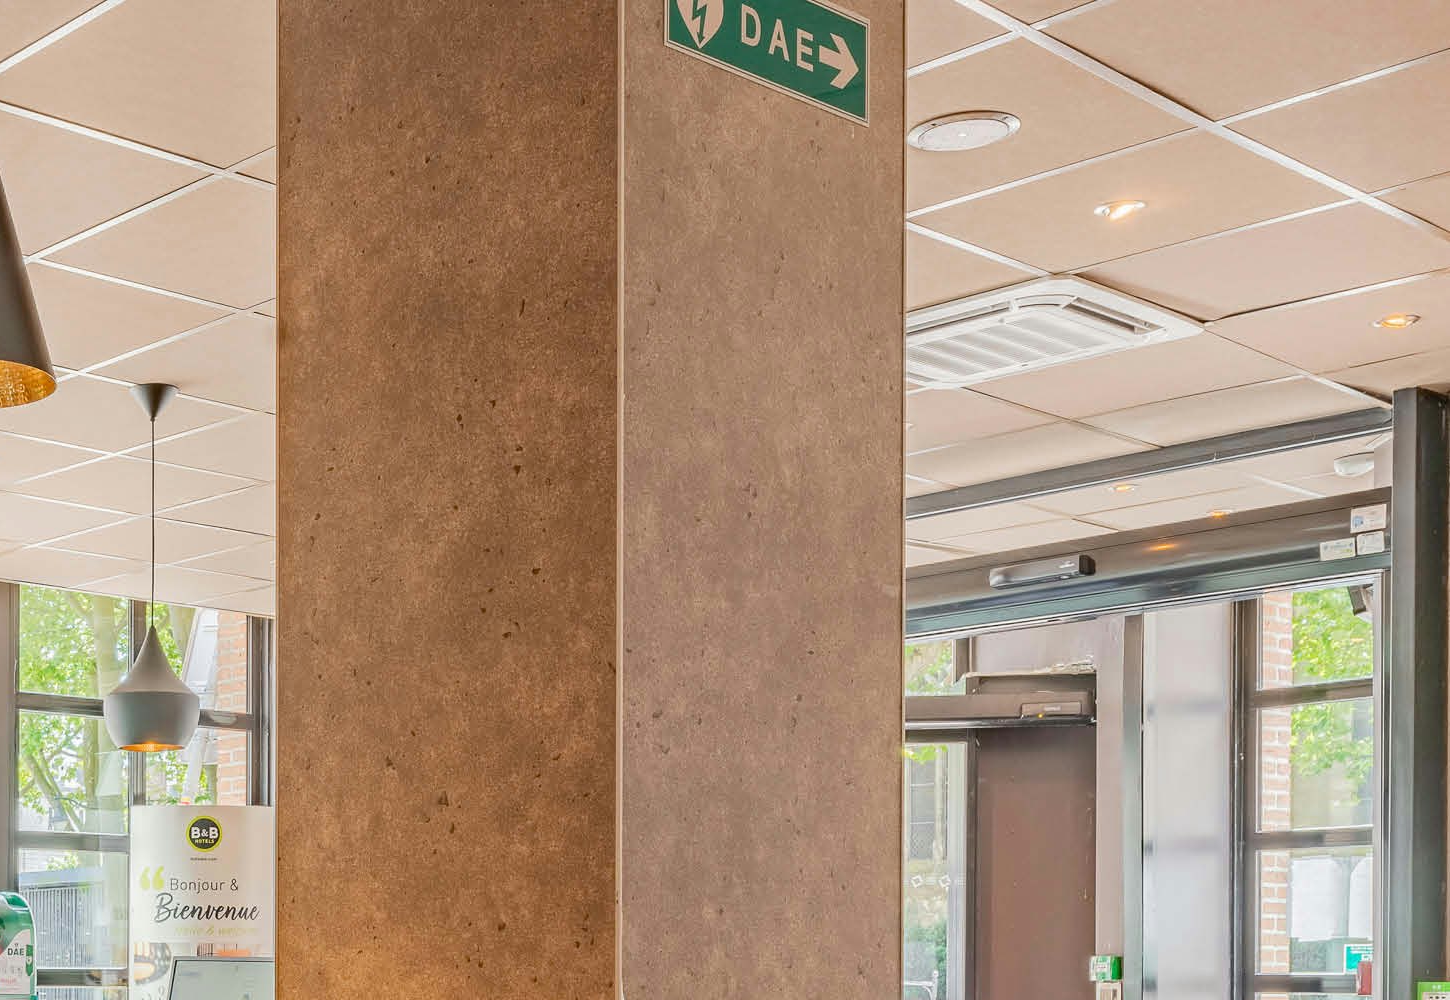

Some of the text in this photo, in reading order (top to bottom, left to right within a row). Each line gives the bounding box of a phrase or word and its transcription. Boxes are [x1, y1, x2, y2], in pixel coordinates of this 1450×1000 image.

[741, 3, 814, 72] DAE
[191, 826, 218, 839] B&B
[170, 878, 239, 894] Bonjour &
[154, 892, 260, 923] Bienvenue
[7, 947, 25, 956] DAE
